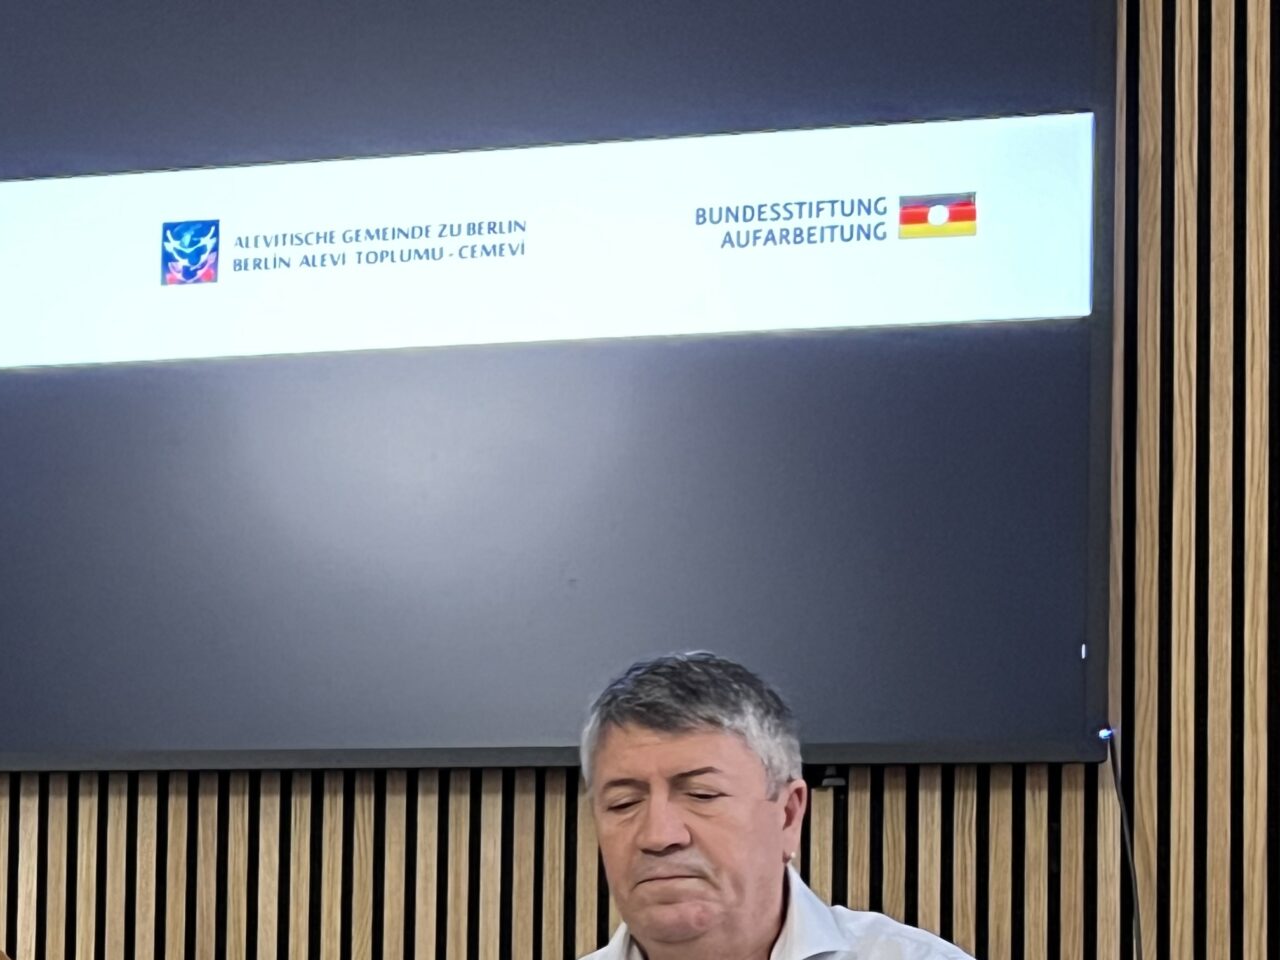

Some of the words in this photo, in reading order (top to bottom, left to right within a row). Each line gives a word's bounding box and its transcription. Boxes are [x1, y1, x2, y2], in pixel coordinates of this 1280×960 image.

[695, 196, 888, 226] BUNDESSTIFTUNG
[233, 230, 337, 249] ALEVITISCHE
[341, 224, 433, 244] GEMEINDE
[437, 223, 463, 238] ZU
[466, 219, 527, 236] BERLIN
[720, 221, 888, 249] AUFARBEITUNG
[355, 246, 444, 265] TOPLUMU
